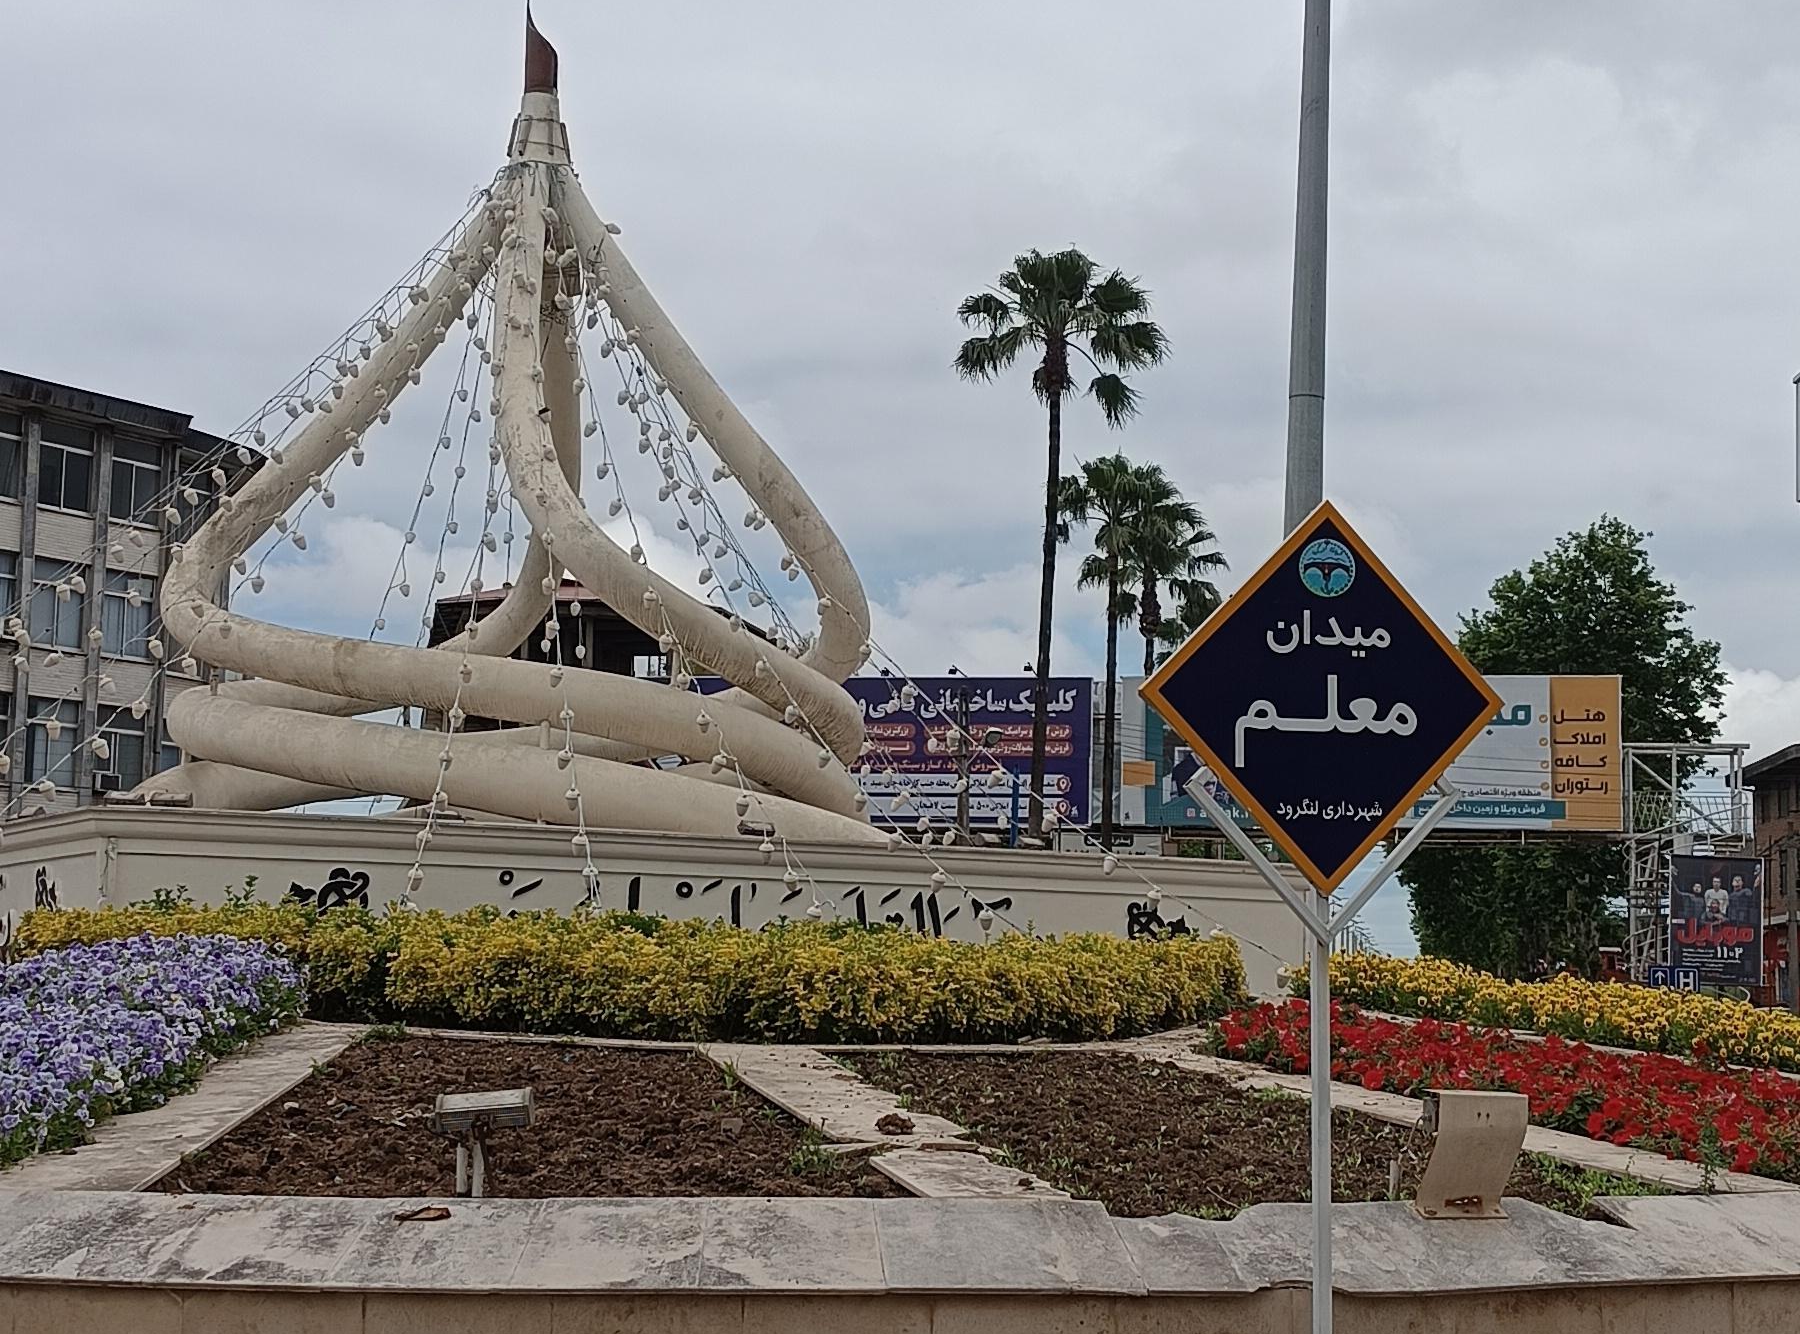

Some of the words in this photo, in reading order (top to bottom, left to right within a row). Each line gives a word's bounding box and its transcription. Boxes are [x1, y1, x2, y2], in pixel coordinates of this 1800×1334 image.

[1266, 609, 1391, 658] میدان
[921, 688, 1007, 719] ساخمانی
[1009, 688, 1077, 718] کلییک
[1234, 674, 1418, 768] معلم
[1552, 708, 1606, 725] هتل
[1552, 731, 1606, 746] املاک
[1553, 754, 1608, 768] کافه
[1276, 798, 1319, 821] لنگرود
[1322, 800, 1383, 822] شهرداری
[1500, 803, 1517, 816] ویلا
[1517, 803, 1546, 815] فروش
[1677, 917, 1755, 946] موبایل
[1679, 971, 1694, 990] H
